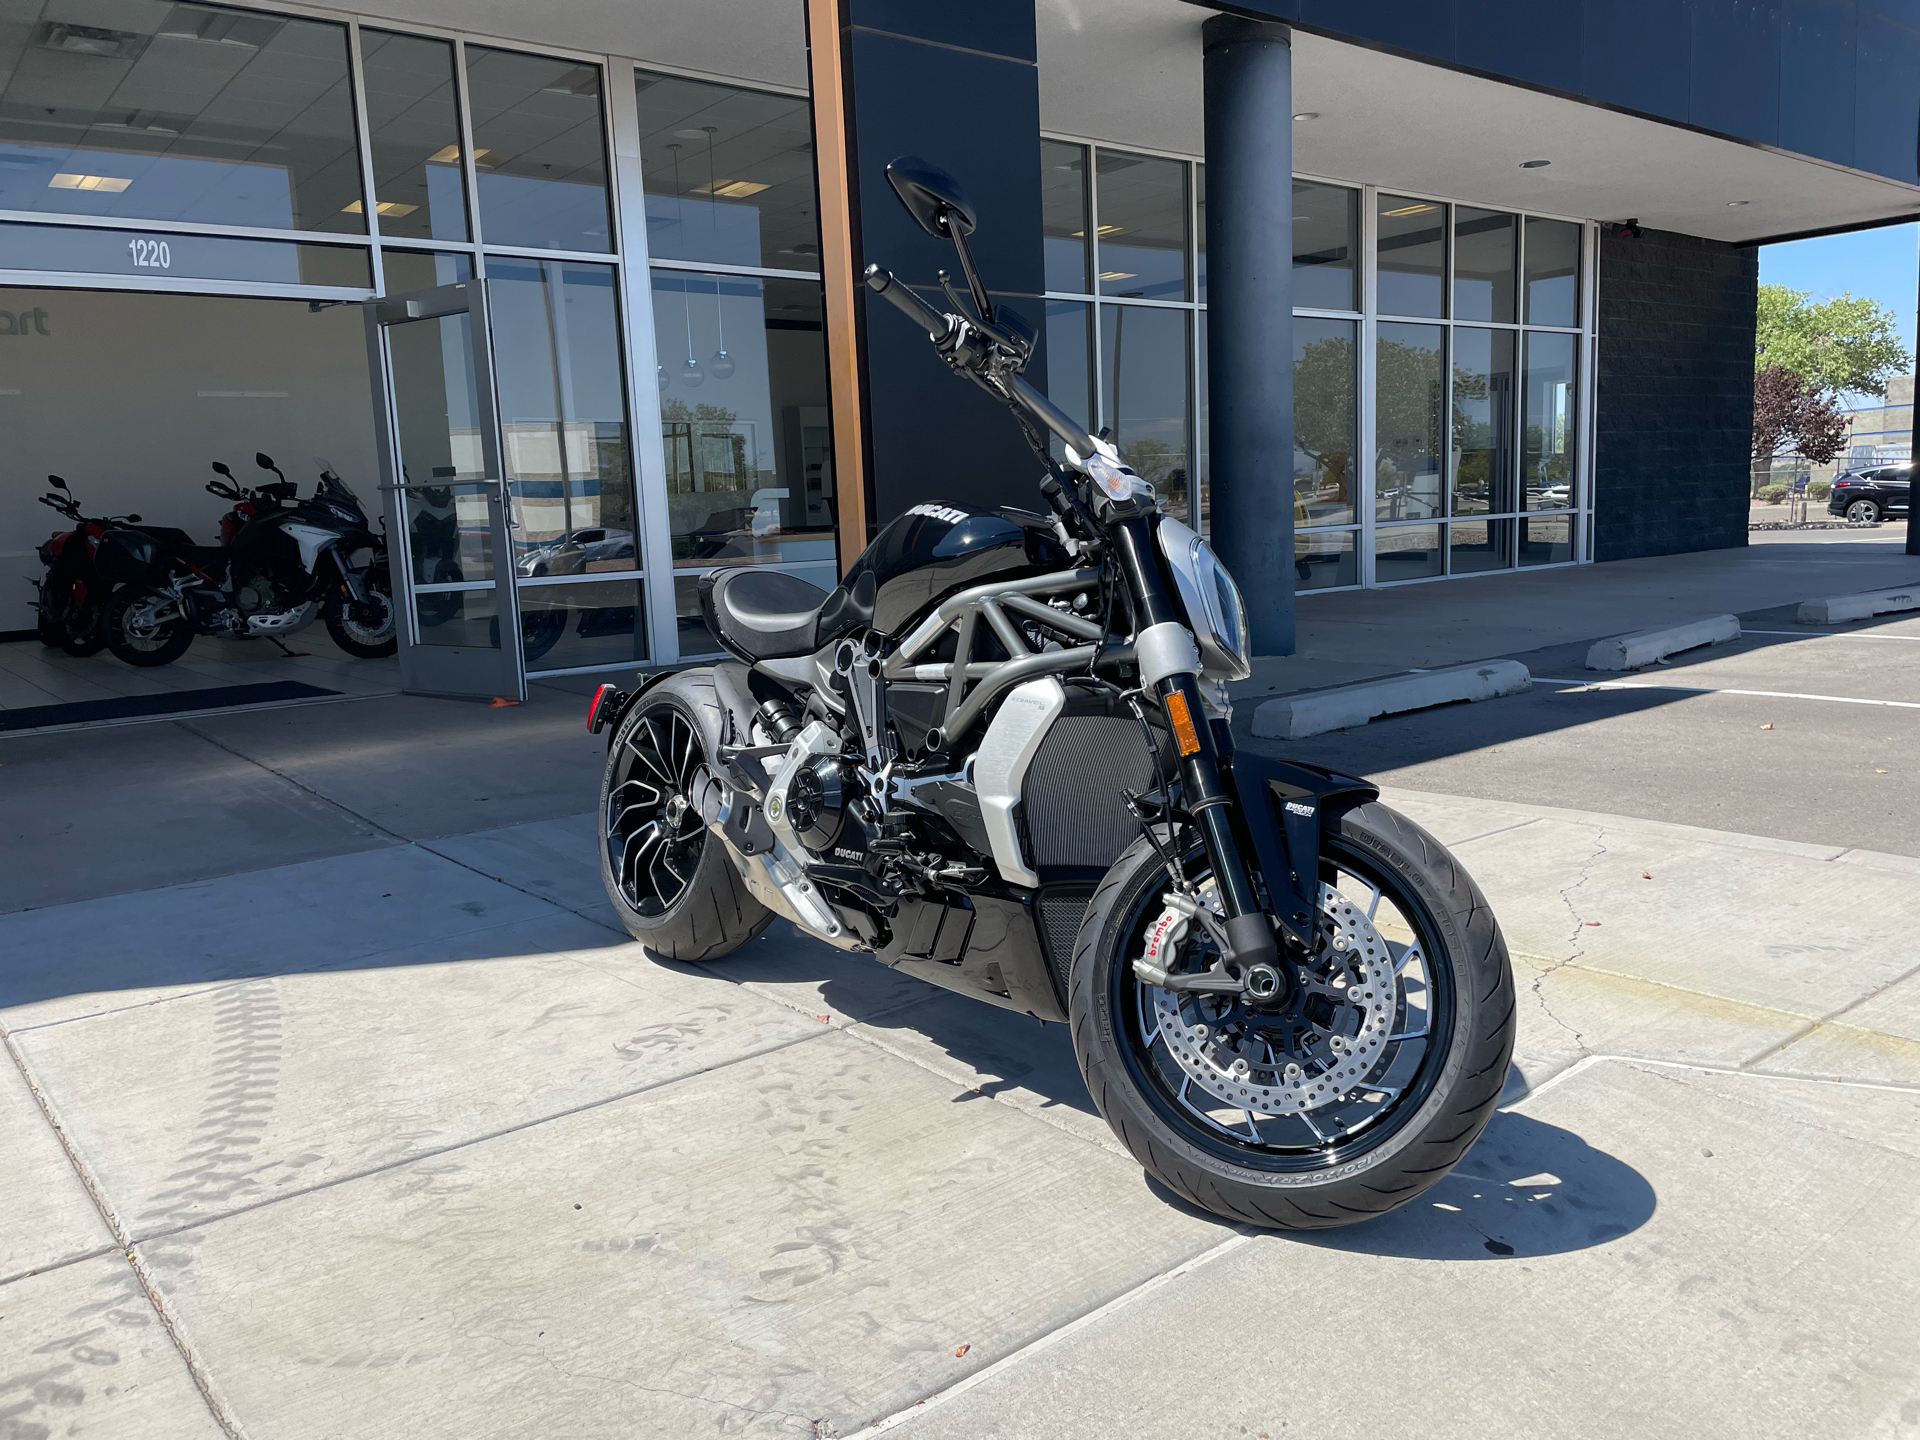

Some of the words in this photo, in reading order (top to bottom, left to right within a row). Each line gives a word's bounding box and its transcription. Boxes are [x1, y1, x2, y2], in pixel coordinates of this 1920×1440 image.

[129, 239, 170, 268] 1220
[904, 504, 969, 525] DUCATI
[1286, 801, 1316, 814] DUCATI
[834, 847, 864, 861] DUCATI
[1359, 831, 1425, 888] DIABLO
[1437, 908, 1466, 977] ROSSO
[1147, 915, 1172, 957] brembo
